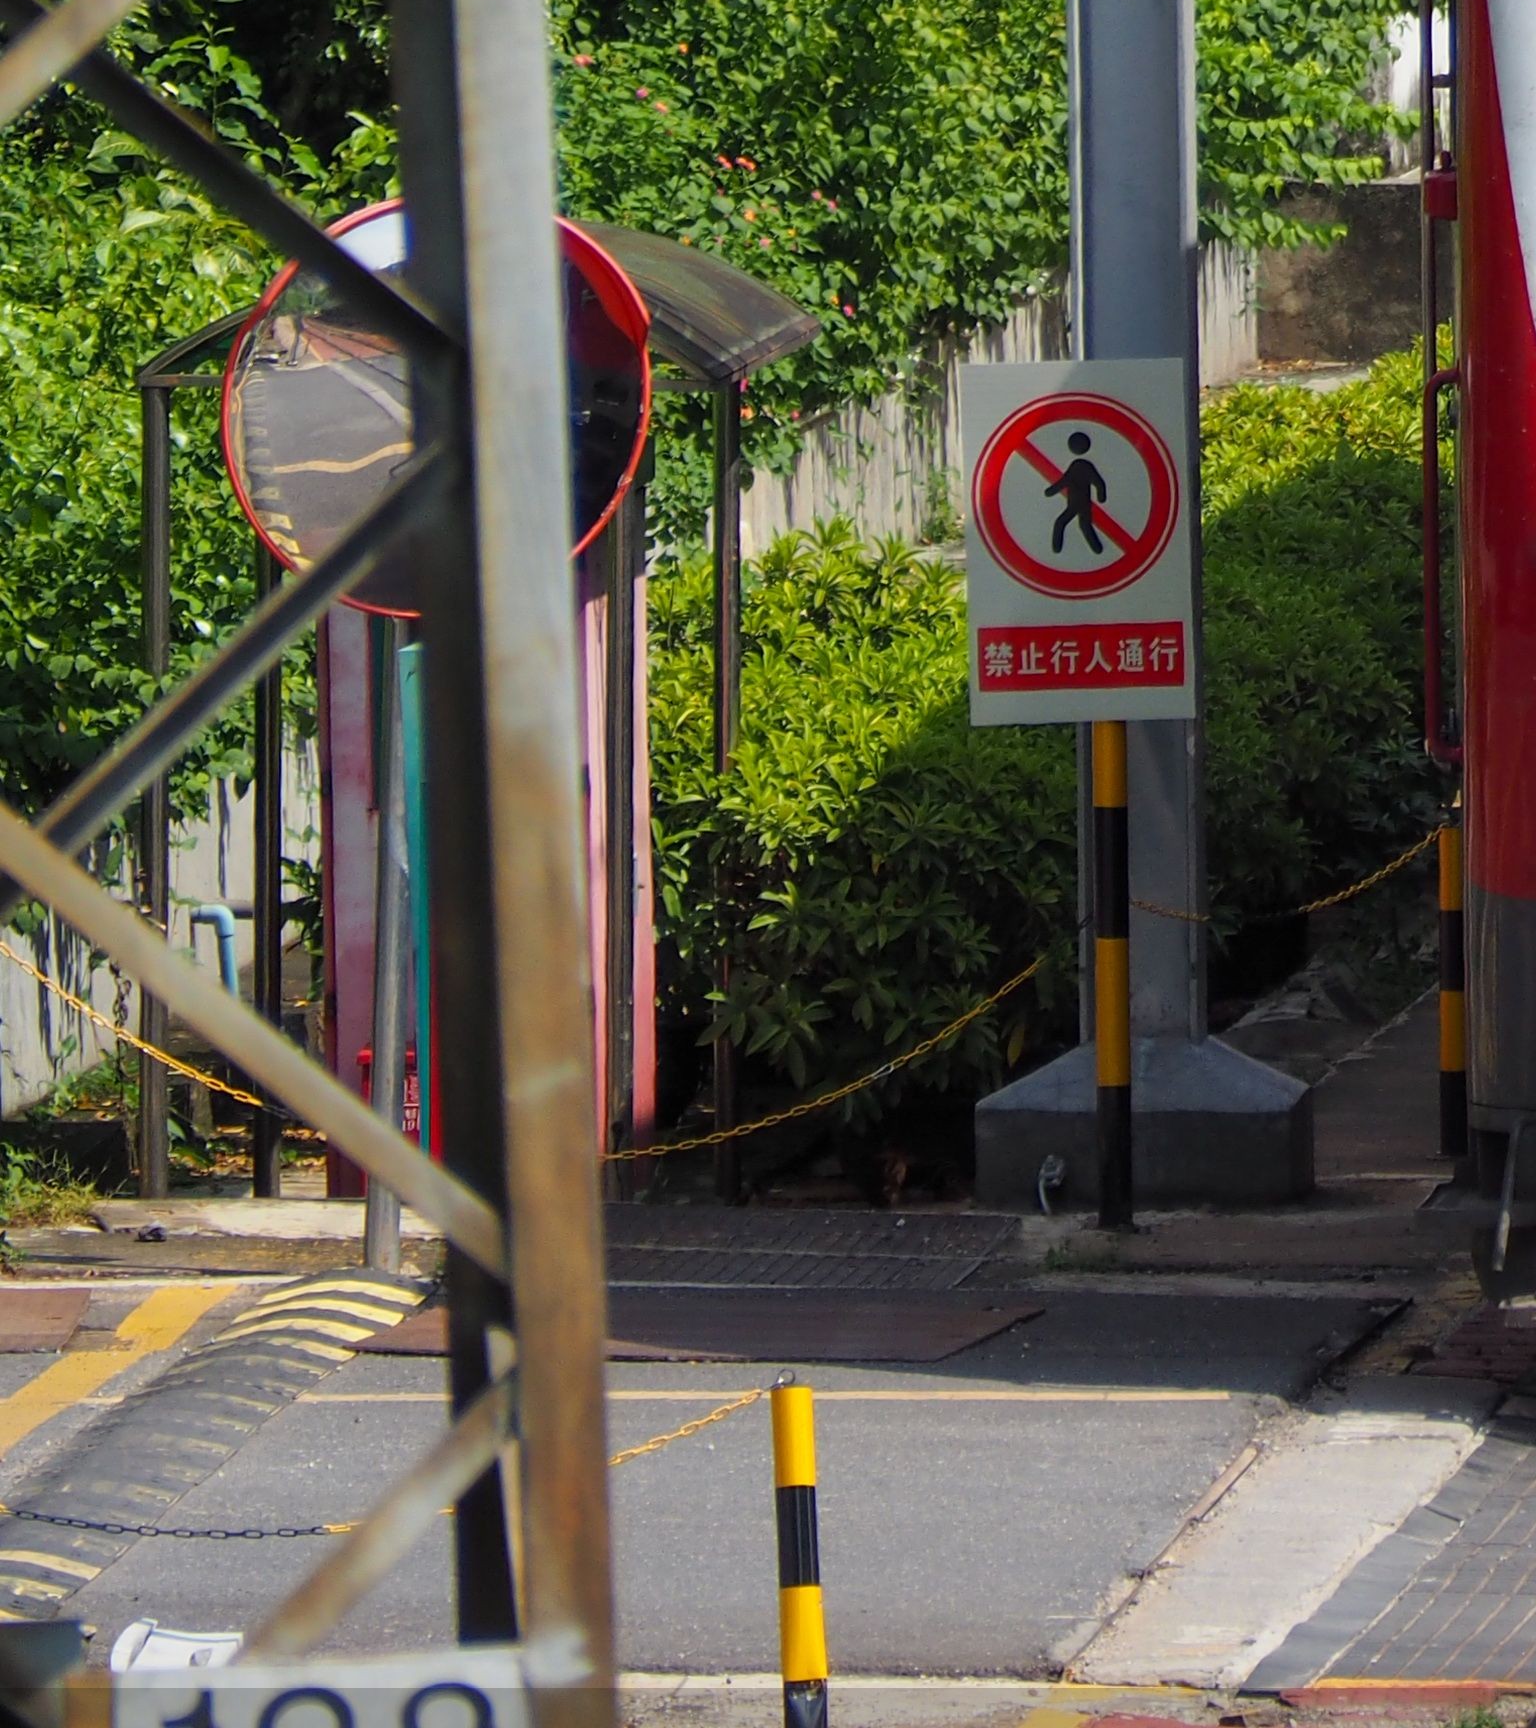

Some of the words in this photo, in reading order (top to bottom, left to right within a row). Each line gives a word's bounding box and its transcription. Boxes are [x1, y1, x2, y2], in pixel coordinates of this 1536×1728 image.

[984, 636, 1179, 678] 禁止行人通行
